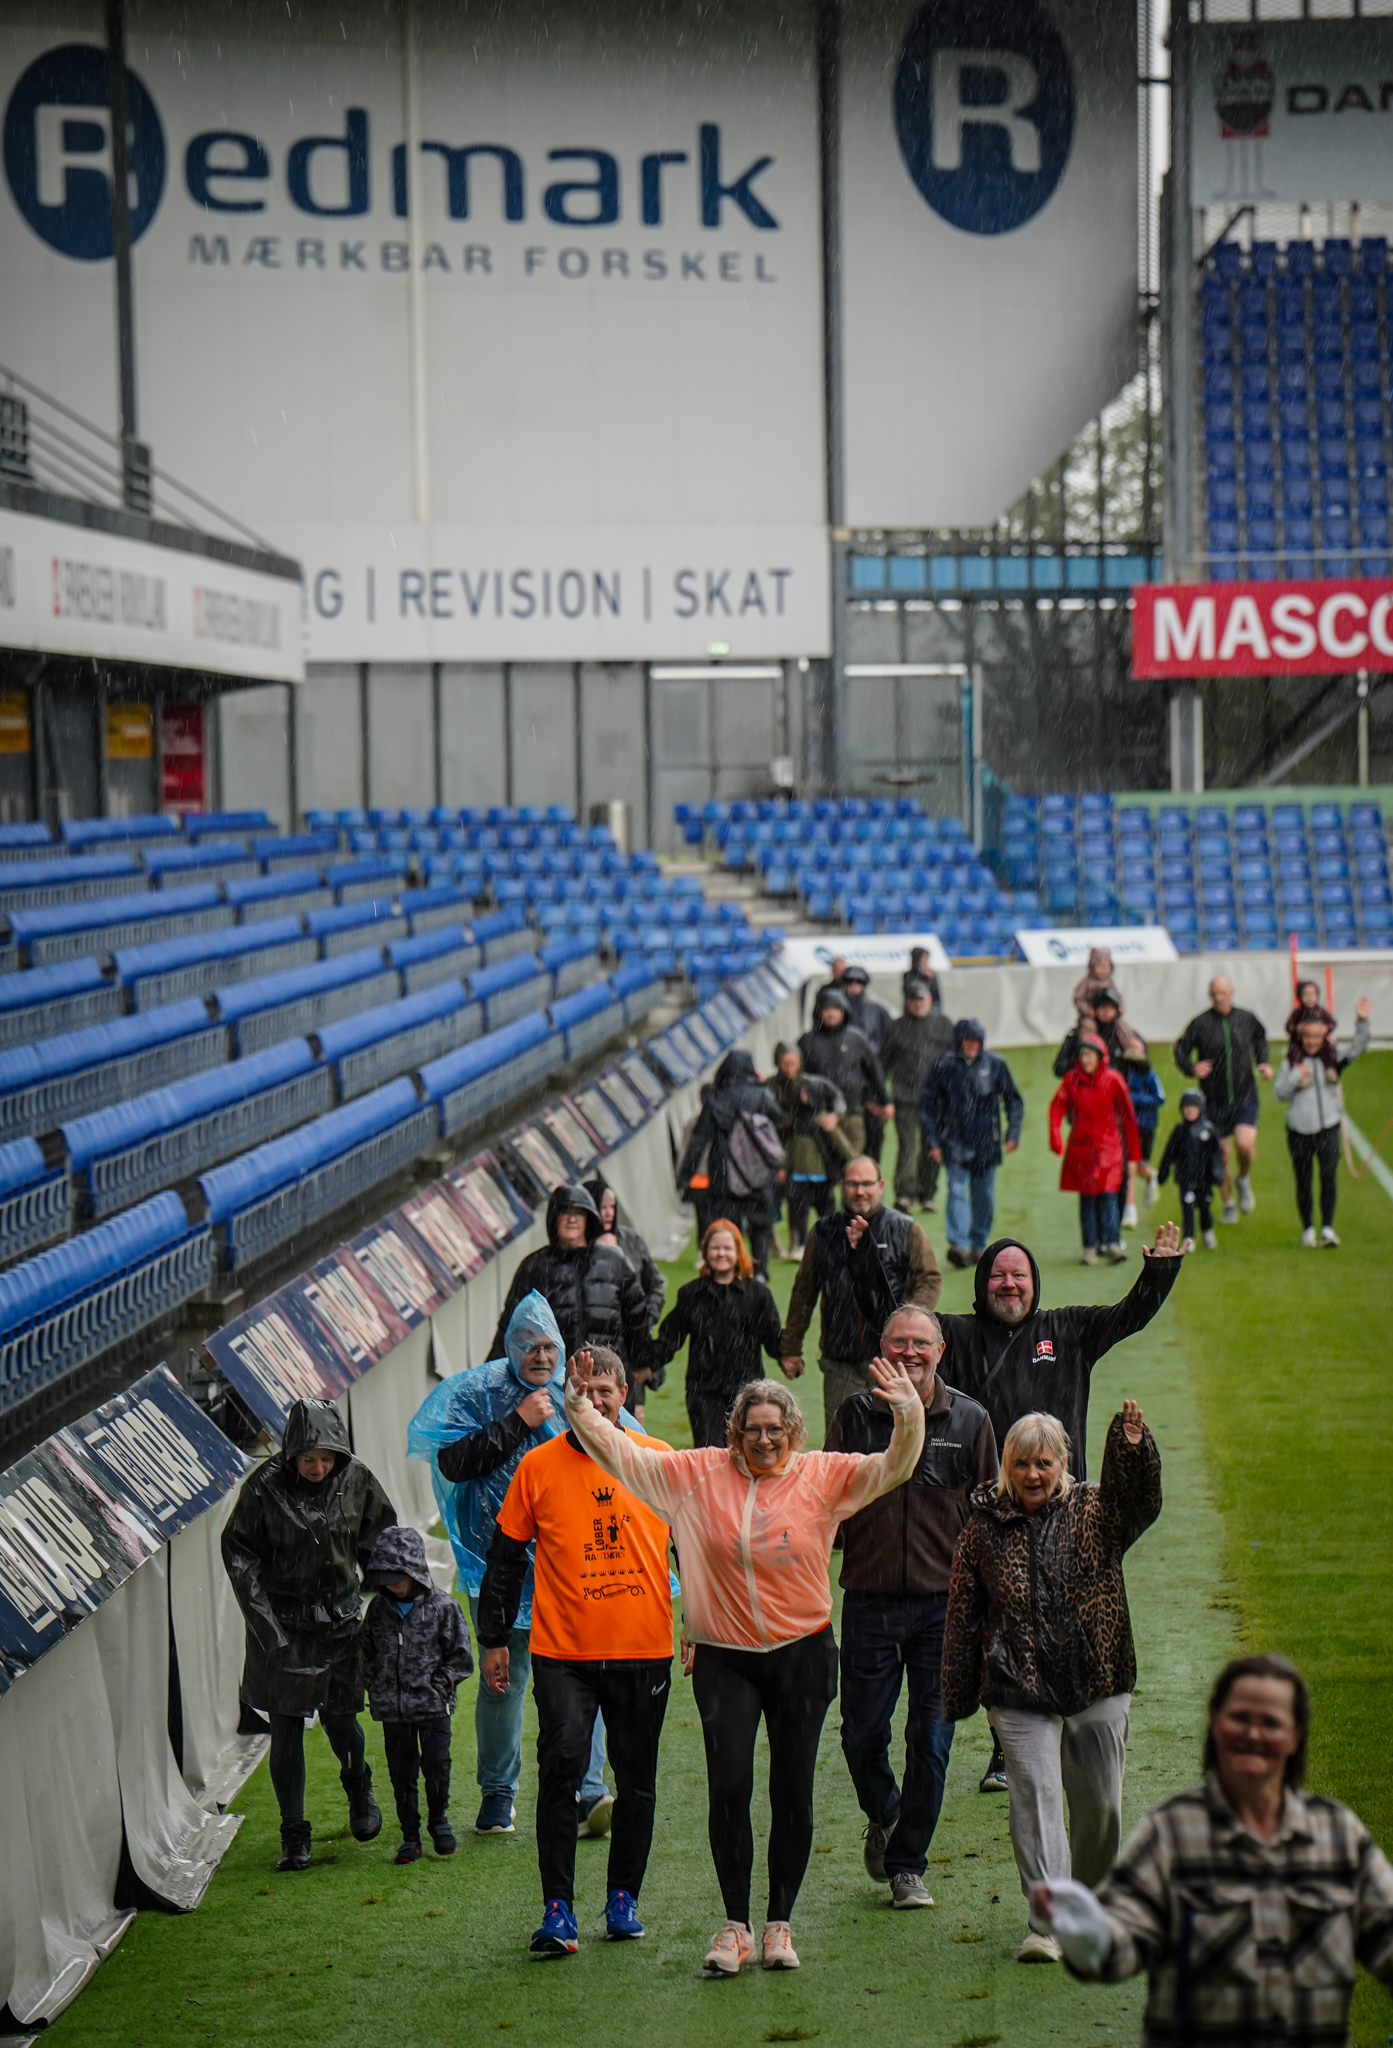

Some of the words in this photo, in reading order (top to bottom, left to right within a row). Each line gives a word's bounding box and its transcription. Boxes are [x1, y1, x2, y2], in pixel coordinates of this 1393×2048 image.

[930, 48, 1041, 173] R
[187, 233, 493, 277] MÆRKBAR
[523, 245, 779, 285] FORSKEL
[398, 567, 622, 620] REVISION
[672, 567, 793, 620] SKAT
[102, 1398, 214, 1507] VORUP
